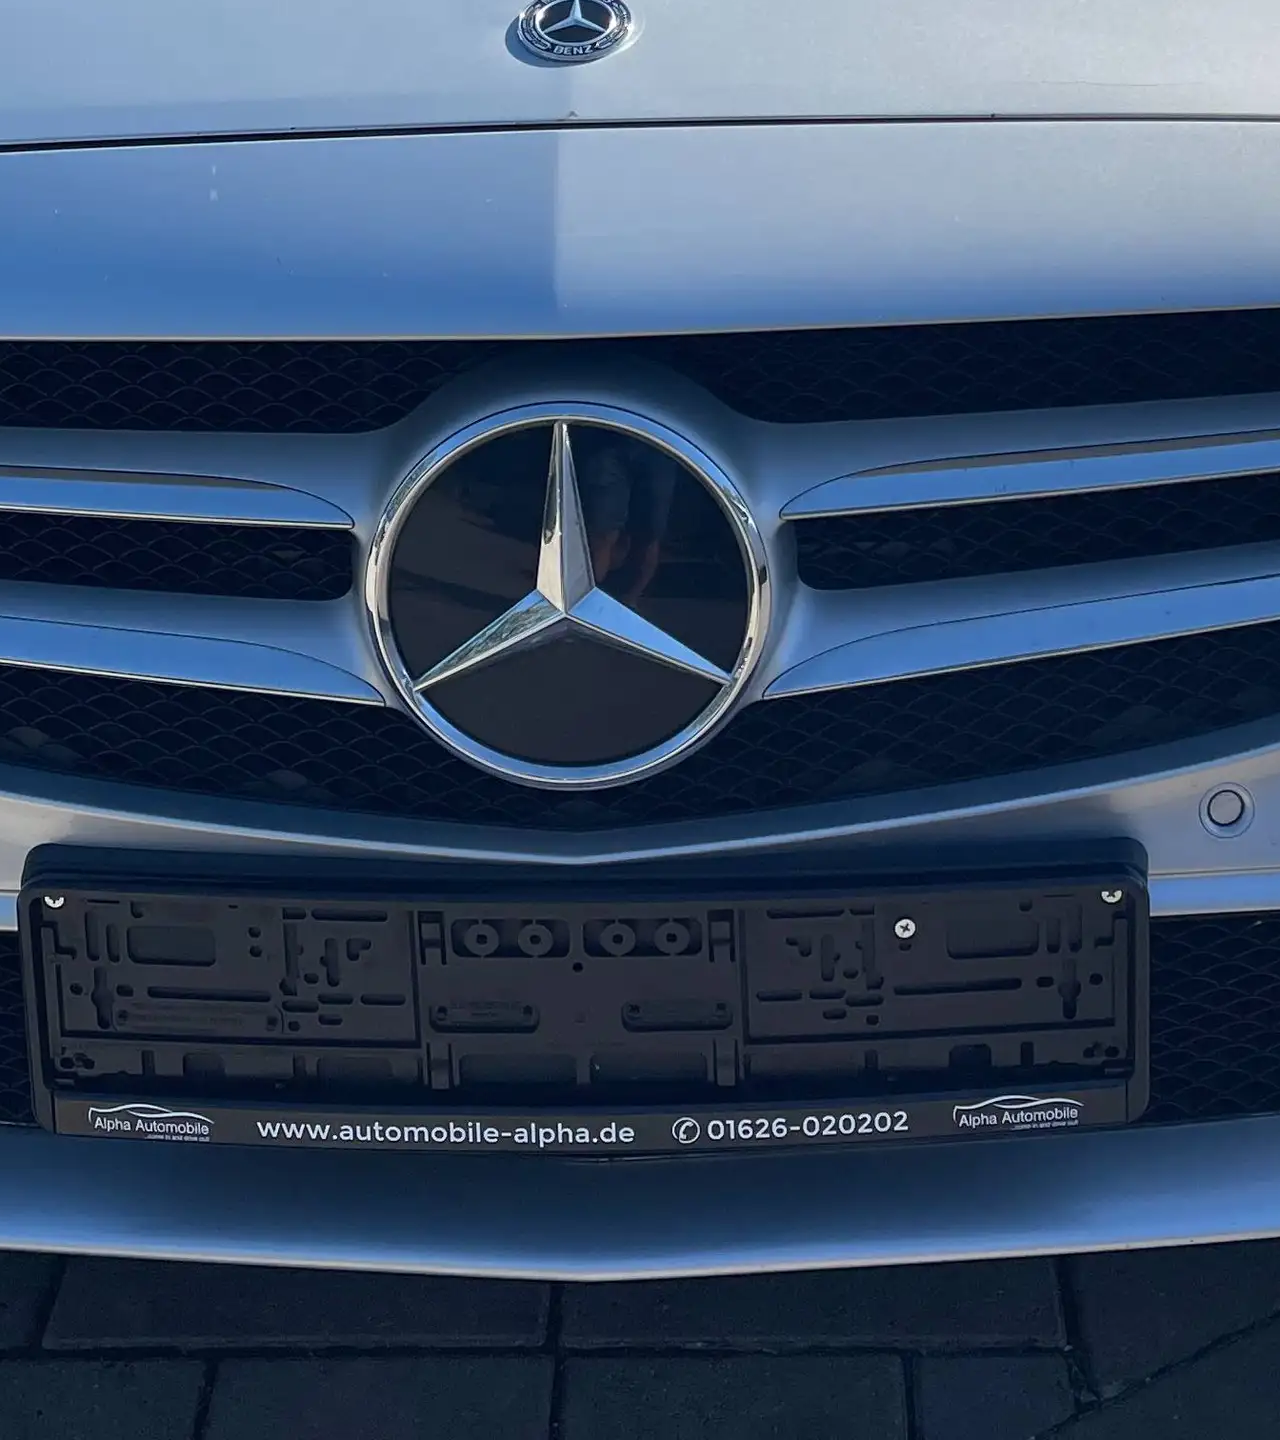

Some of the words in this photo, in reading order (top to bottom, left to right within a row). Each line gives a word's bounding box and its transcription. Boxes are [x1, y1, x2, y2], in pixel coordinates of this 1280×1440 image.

[552, 44, 594, 56] BENZ
[94, 1116, 131, 1132] Alpha
[135, 1119, 209, 1135] Automobile
[958, 1113, 998, 1129] Alpha
[1001, 1106, 1078, 1125] Automobile
[256, 1121, 635, 1148] www.automobile-alpha.de
[707, 1110, 909, 1140] 01626-020202
